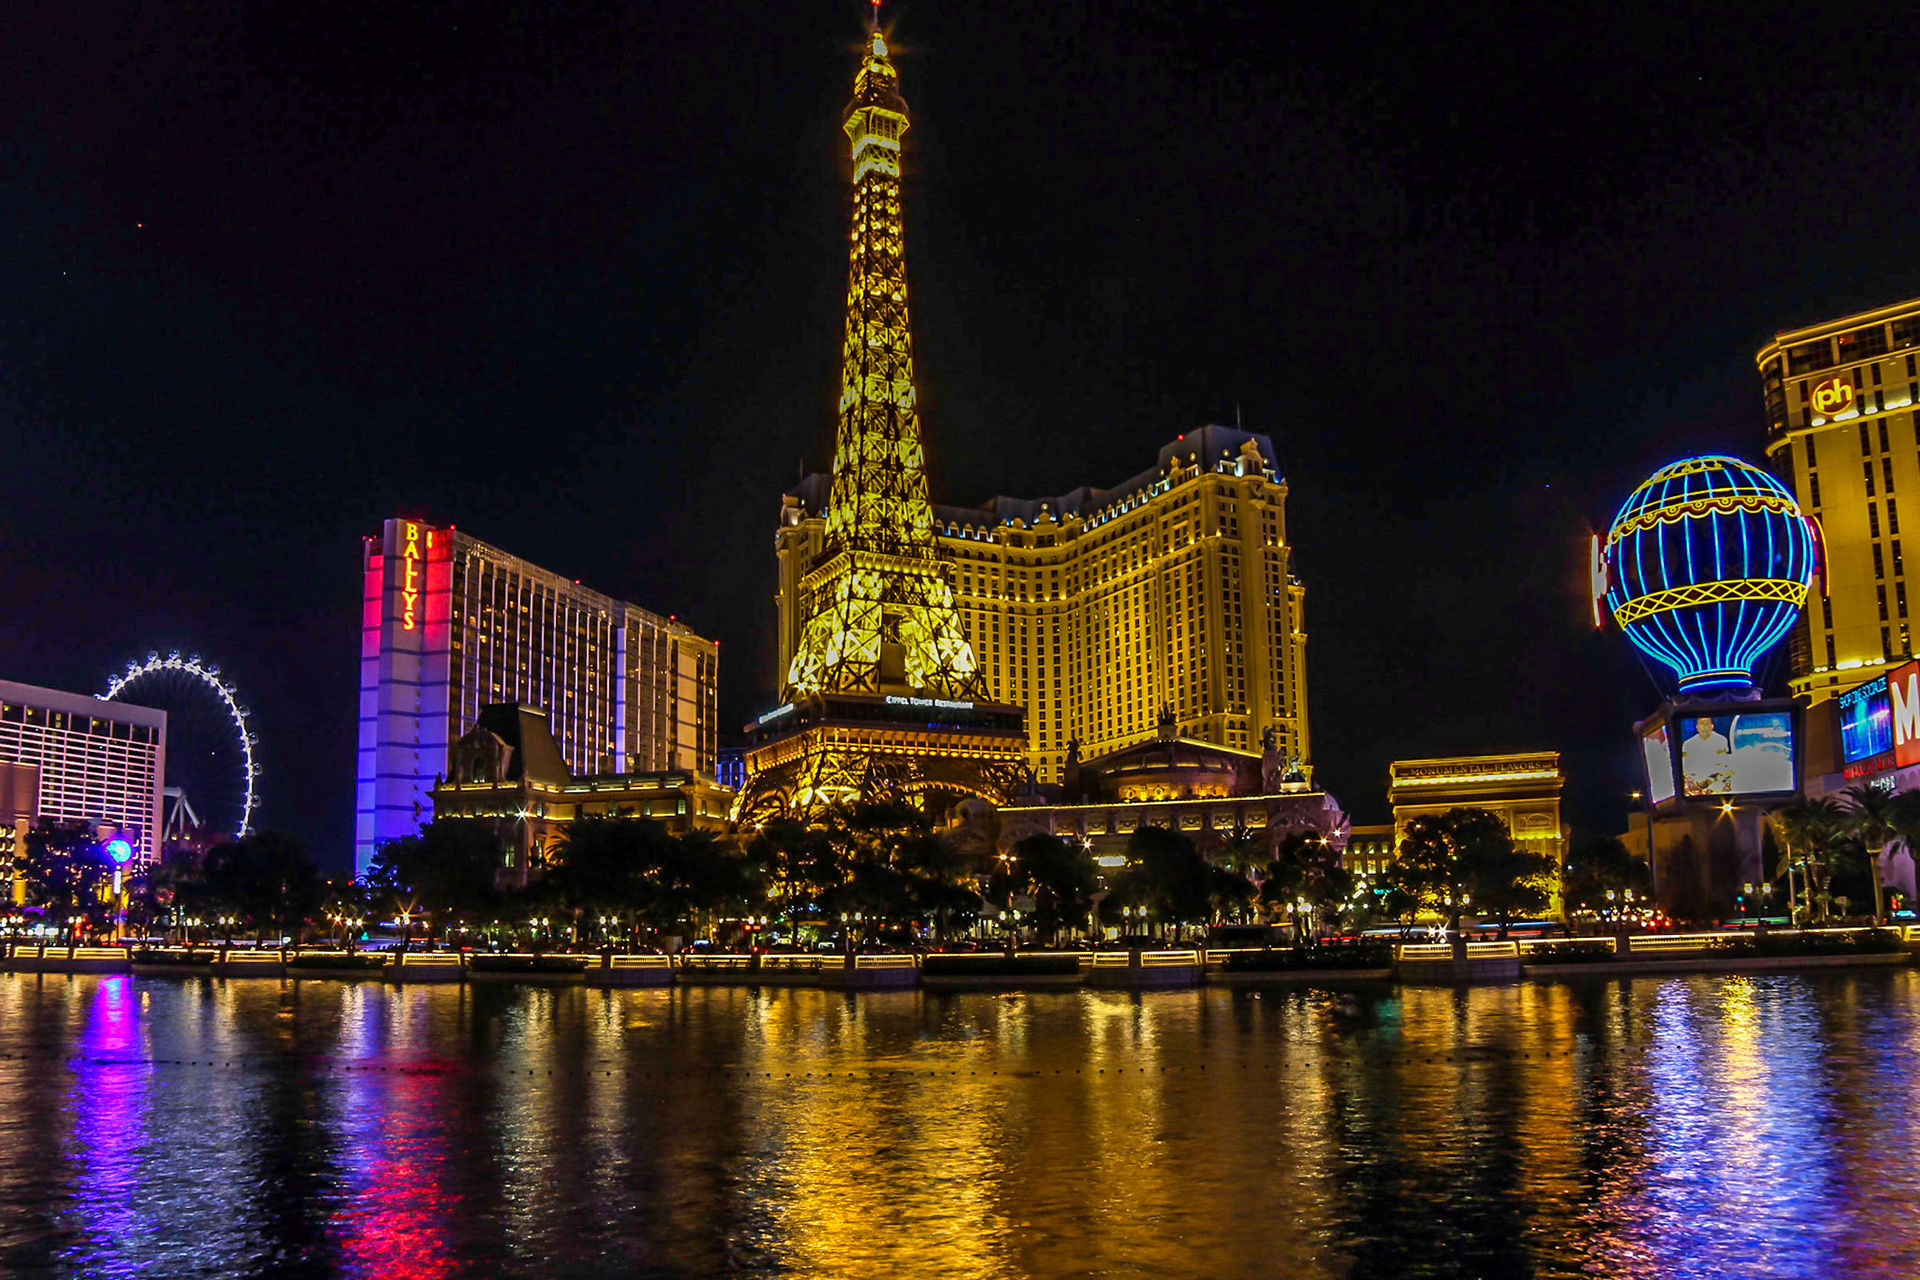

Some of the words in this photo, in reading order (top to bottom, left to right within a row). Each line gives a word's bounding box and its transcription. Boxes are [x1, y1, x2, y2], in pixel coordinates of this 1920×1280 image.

[1816, 378, 1853, 411] ph
[1410, 764, 1487, 776] MONUMENTAL
[1494, 761, 1542, 772] FLAVORS
